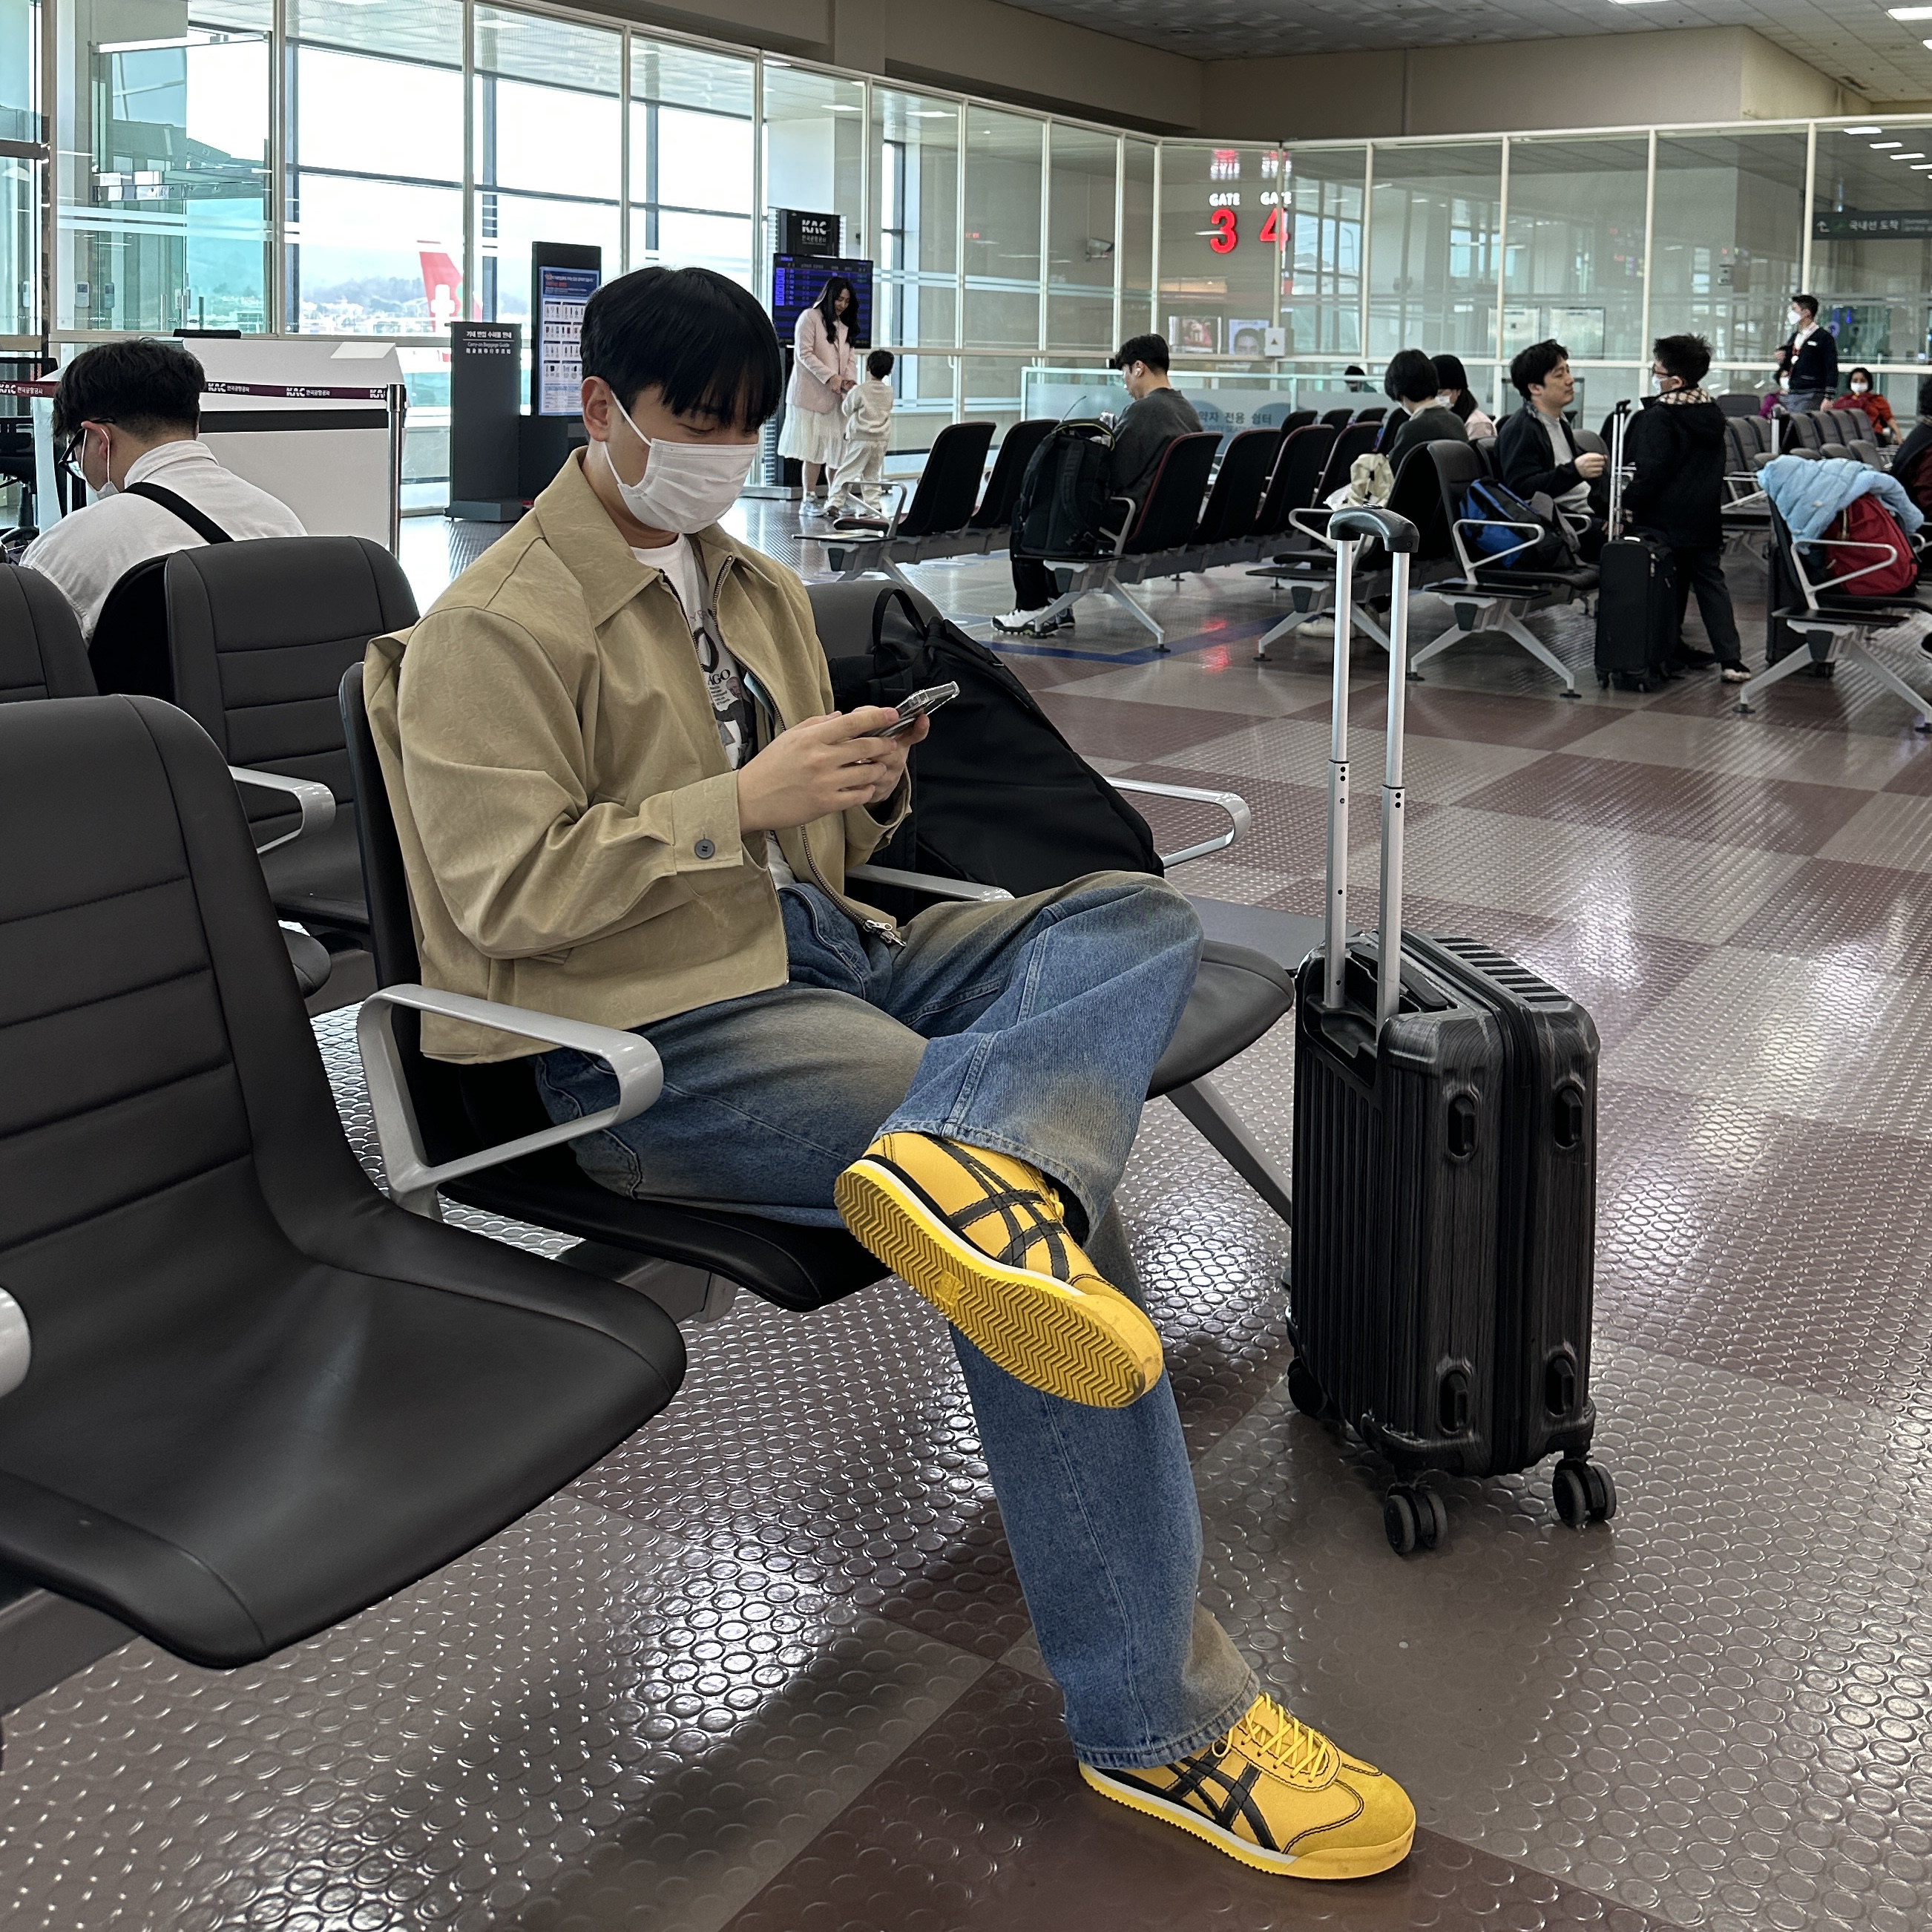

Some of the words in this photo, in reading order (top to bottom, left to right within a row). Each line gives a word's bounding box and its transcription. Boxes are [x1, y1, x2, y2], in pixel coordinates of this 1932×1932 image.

[1209, 192, 1241, 207] GATE
[802, 219, 827, 235] KAC
[1209, 208, 1238, 254] 3
[1259, 207, 1289, 253] 4
[208, 382, 226, 392] KAC
[286, 387, 305, 397] KAC
[1224, 412, 1245, 425] 전용
[1252, 413, 1272, 426] 쉼터
